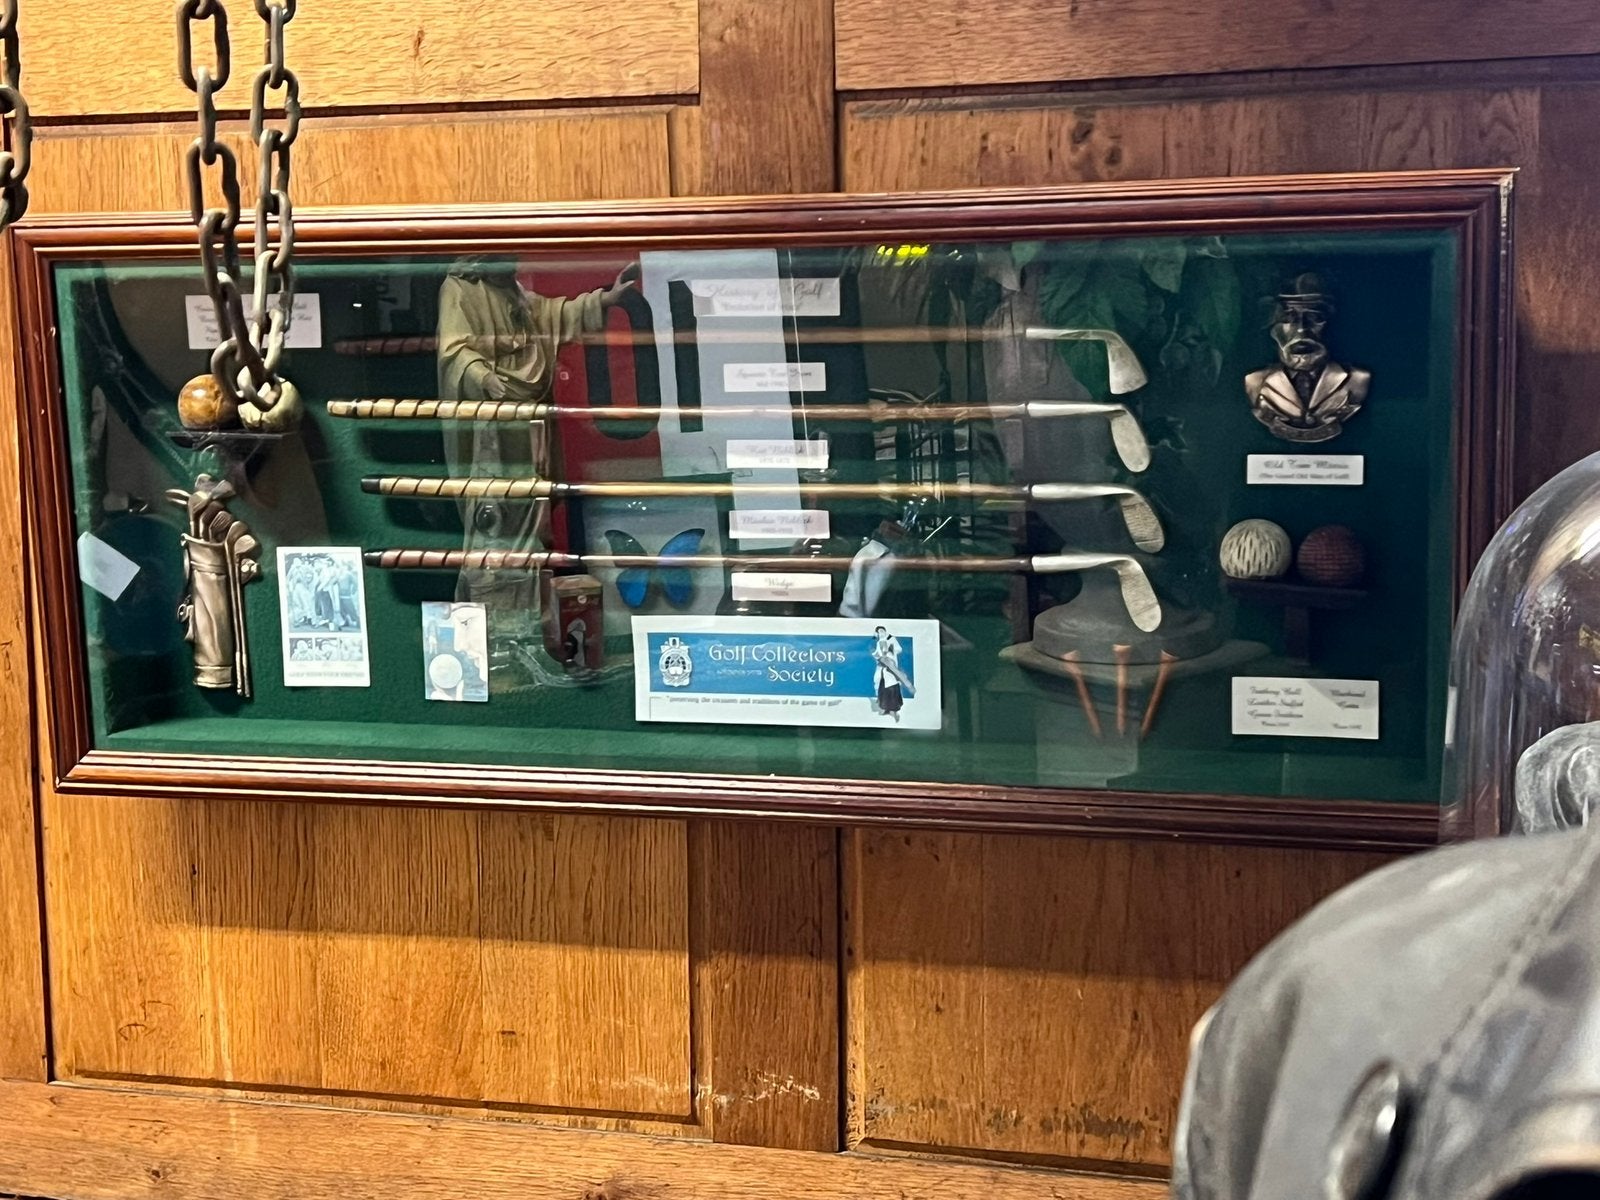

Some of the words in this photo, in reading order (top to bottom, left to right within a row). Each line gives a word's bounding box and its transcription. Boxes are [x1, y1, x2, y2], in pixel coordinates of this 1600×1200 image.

[764, 577, 794, 590] Wedge
[708, 643, 748, 665] Golf
[751, 644, 846, 664] Collectors
[767, 667, 835, 687] Society
